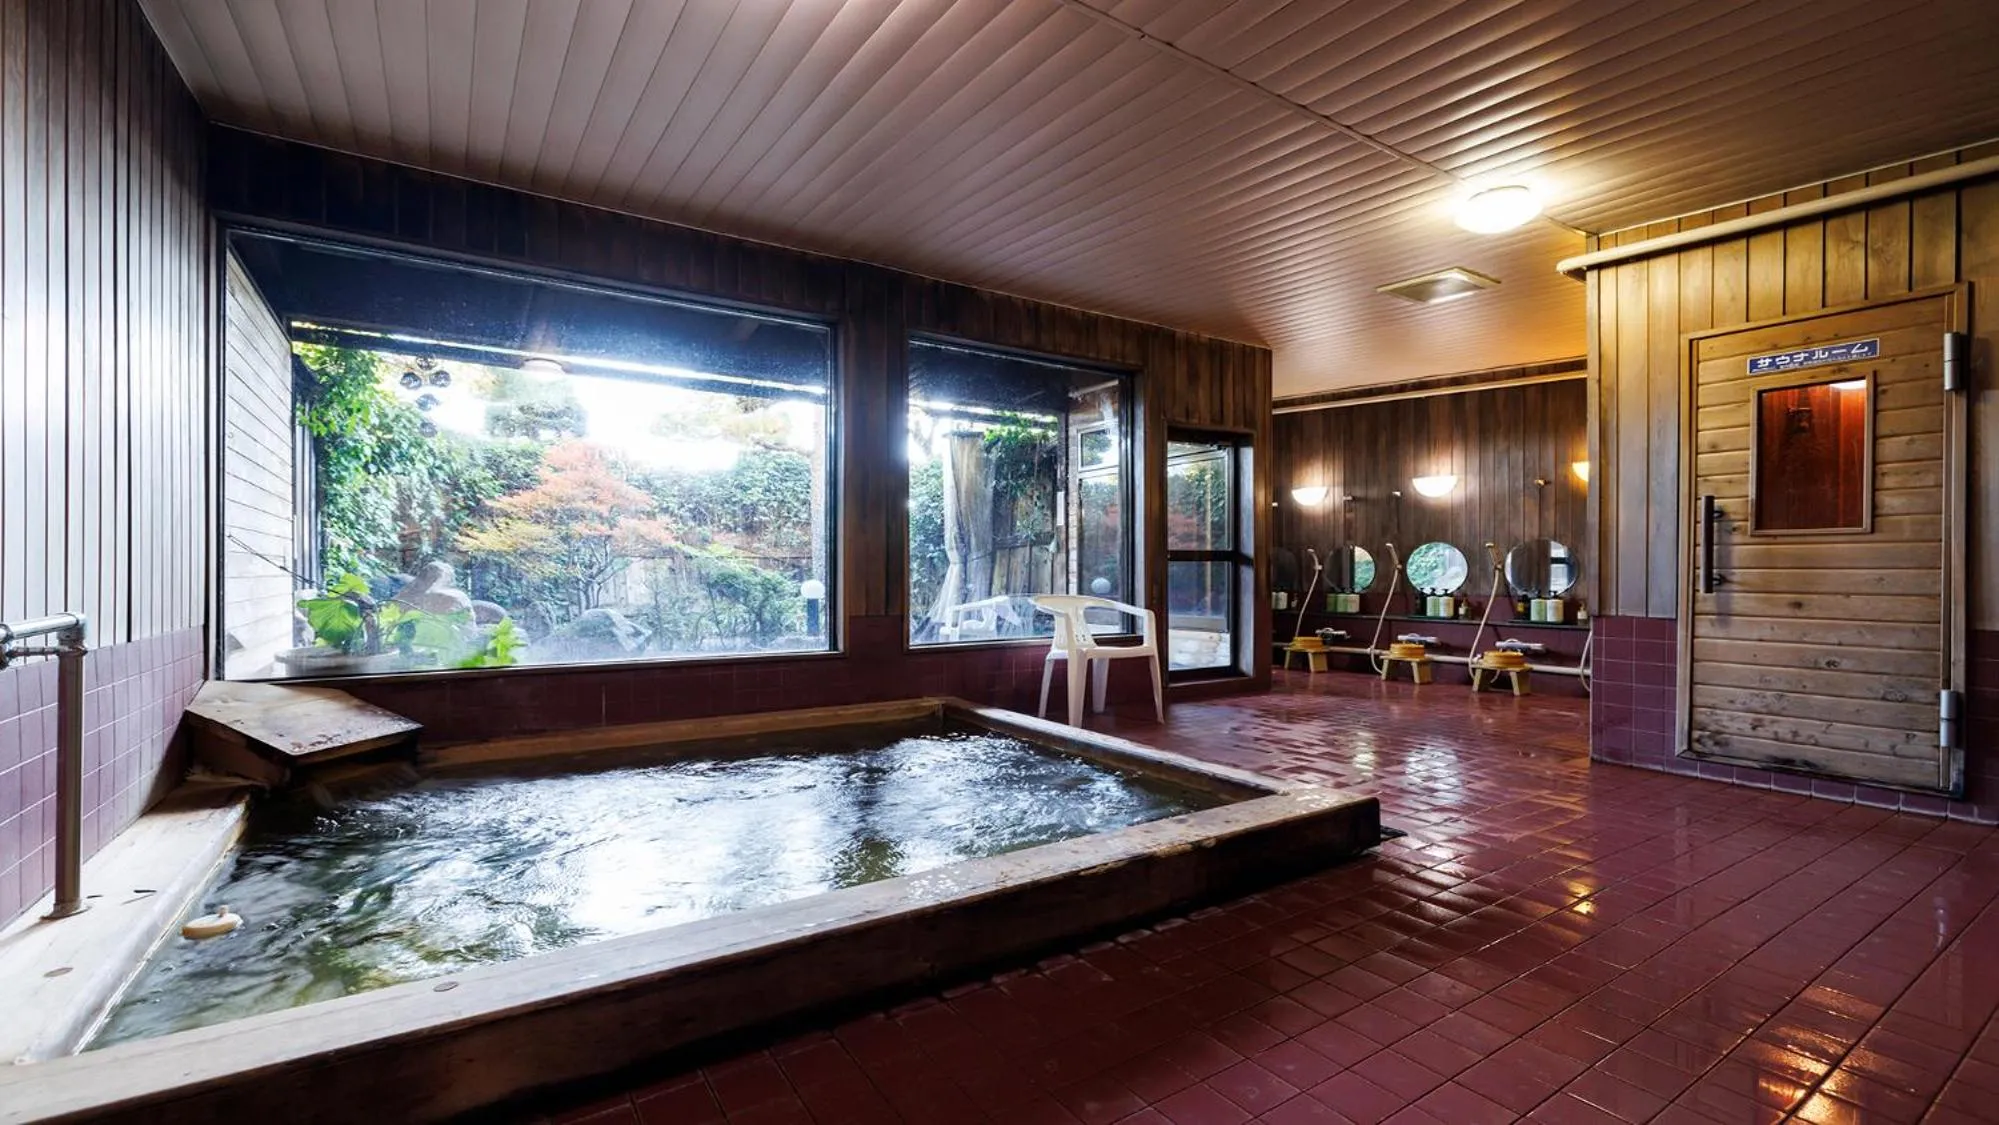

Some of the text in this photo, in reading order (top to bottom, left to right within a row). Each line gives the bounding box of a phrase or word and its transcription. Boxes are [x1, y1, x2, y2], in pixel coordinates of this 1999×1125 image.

[1756, 343, 1869, 368] サウナルーム
